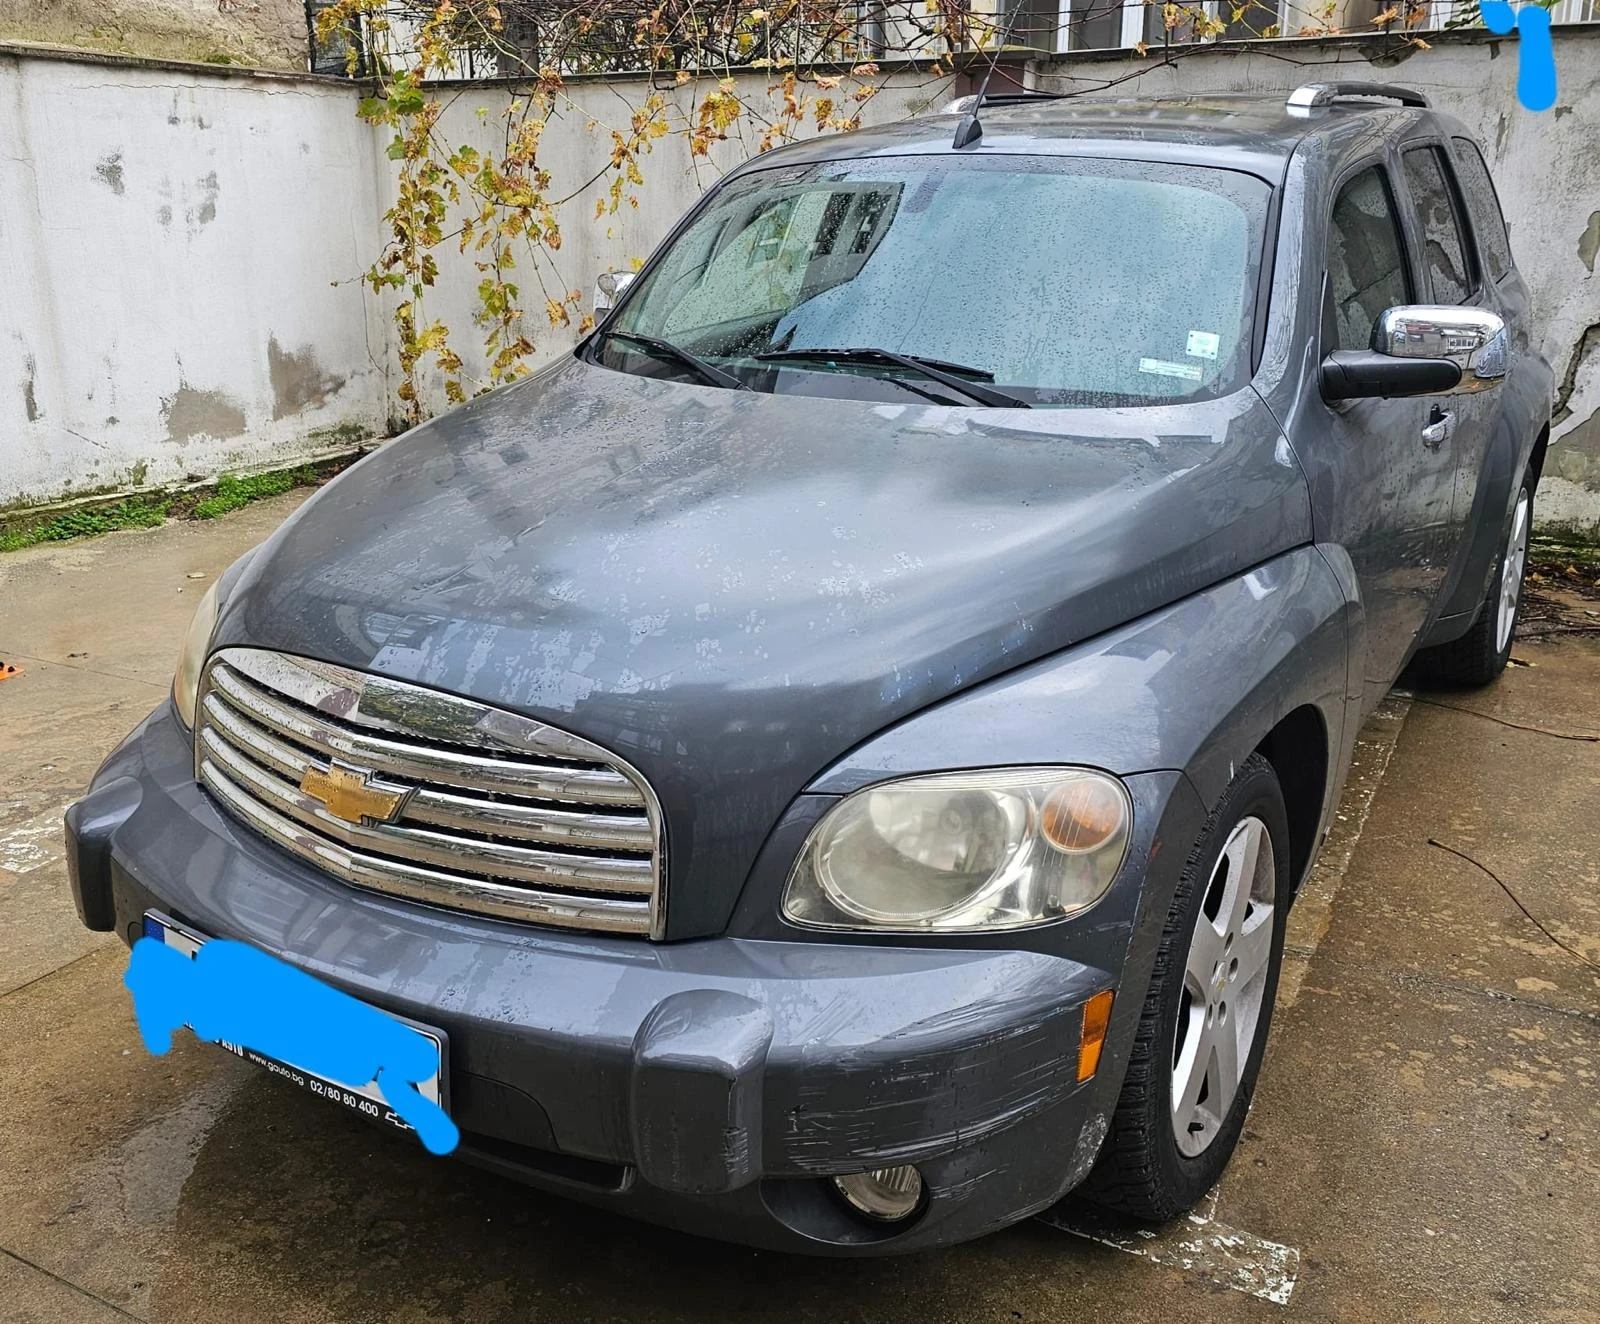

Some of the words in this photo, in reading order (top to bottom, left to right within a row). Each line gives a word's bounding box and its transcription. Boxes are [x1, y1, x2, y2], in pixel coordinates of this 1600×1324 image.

[310, 1080, 341, 1101] 02/80
[343, 1093, 356, 1108] 80
[358, 1101, 379, 1117] 400
